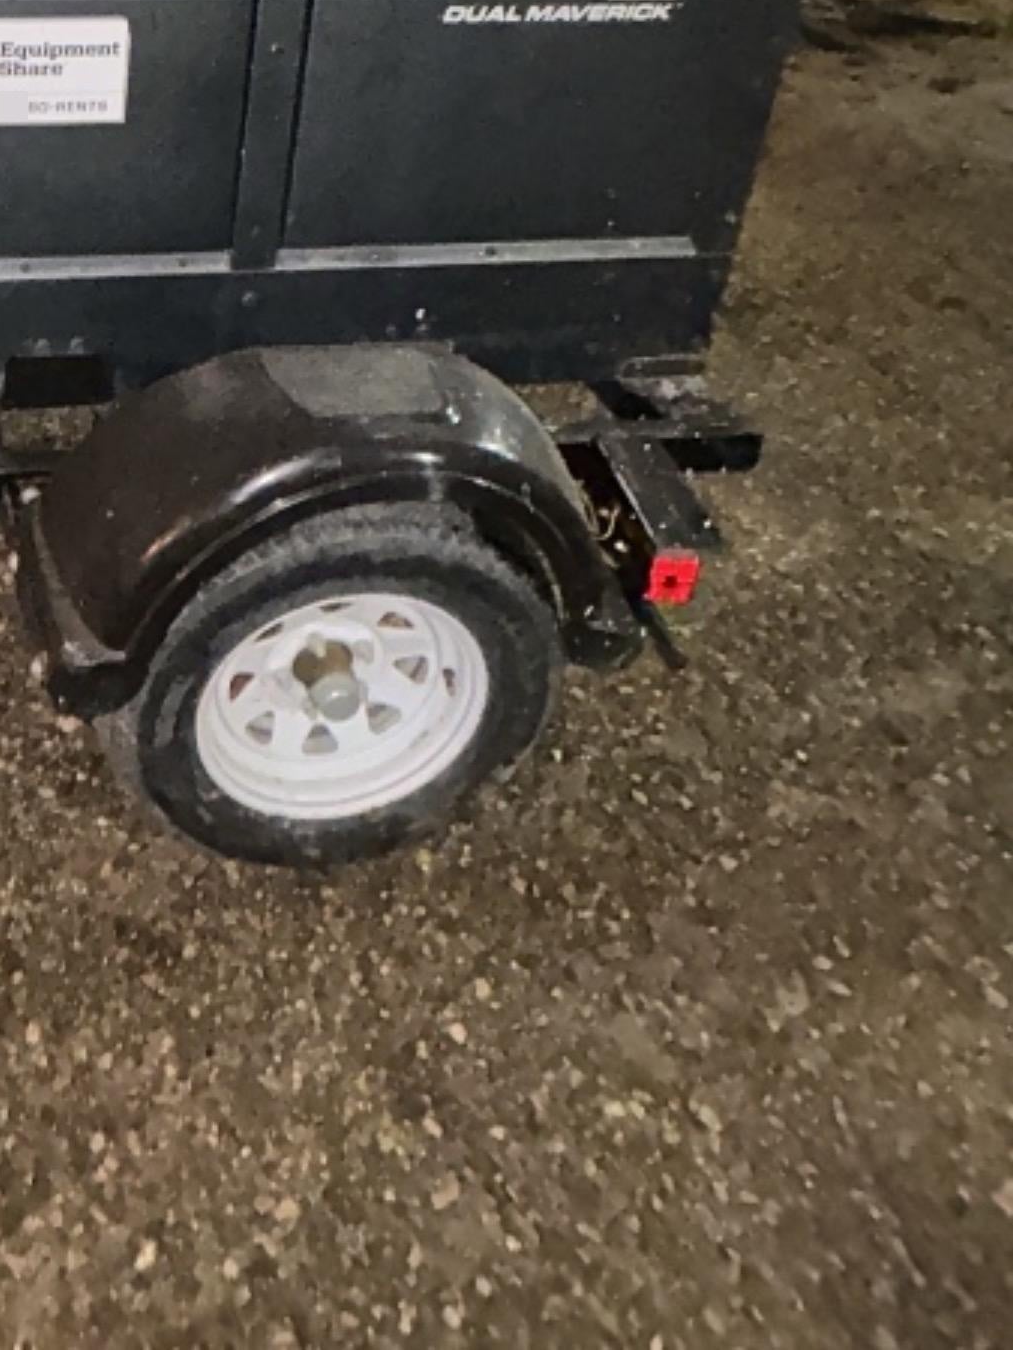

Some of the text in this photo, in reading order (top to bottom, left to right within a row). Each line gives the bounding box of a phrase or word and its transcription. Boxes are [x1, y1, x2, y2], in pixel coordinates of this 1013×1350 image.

[442, 2, 672, 24] DUAL MAVERICK
[0, 41, 120, 61] Equipment
